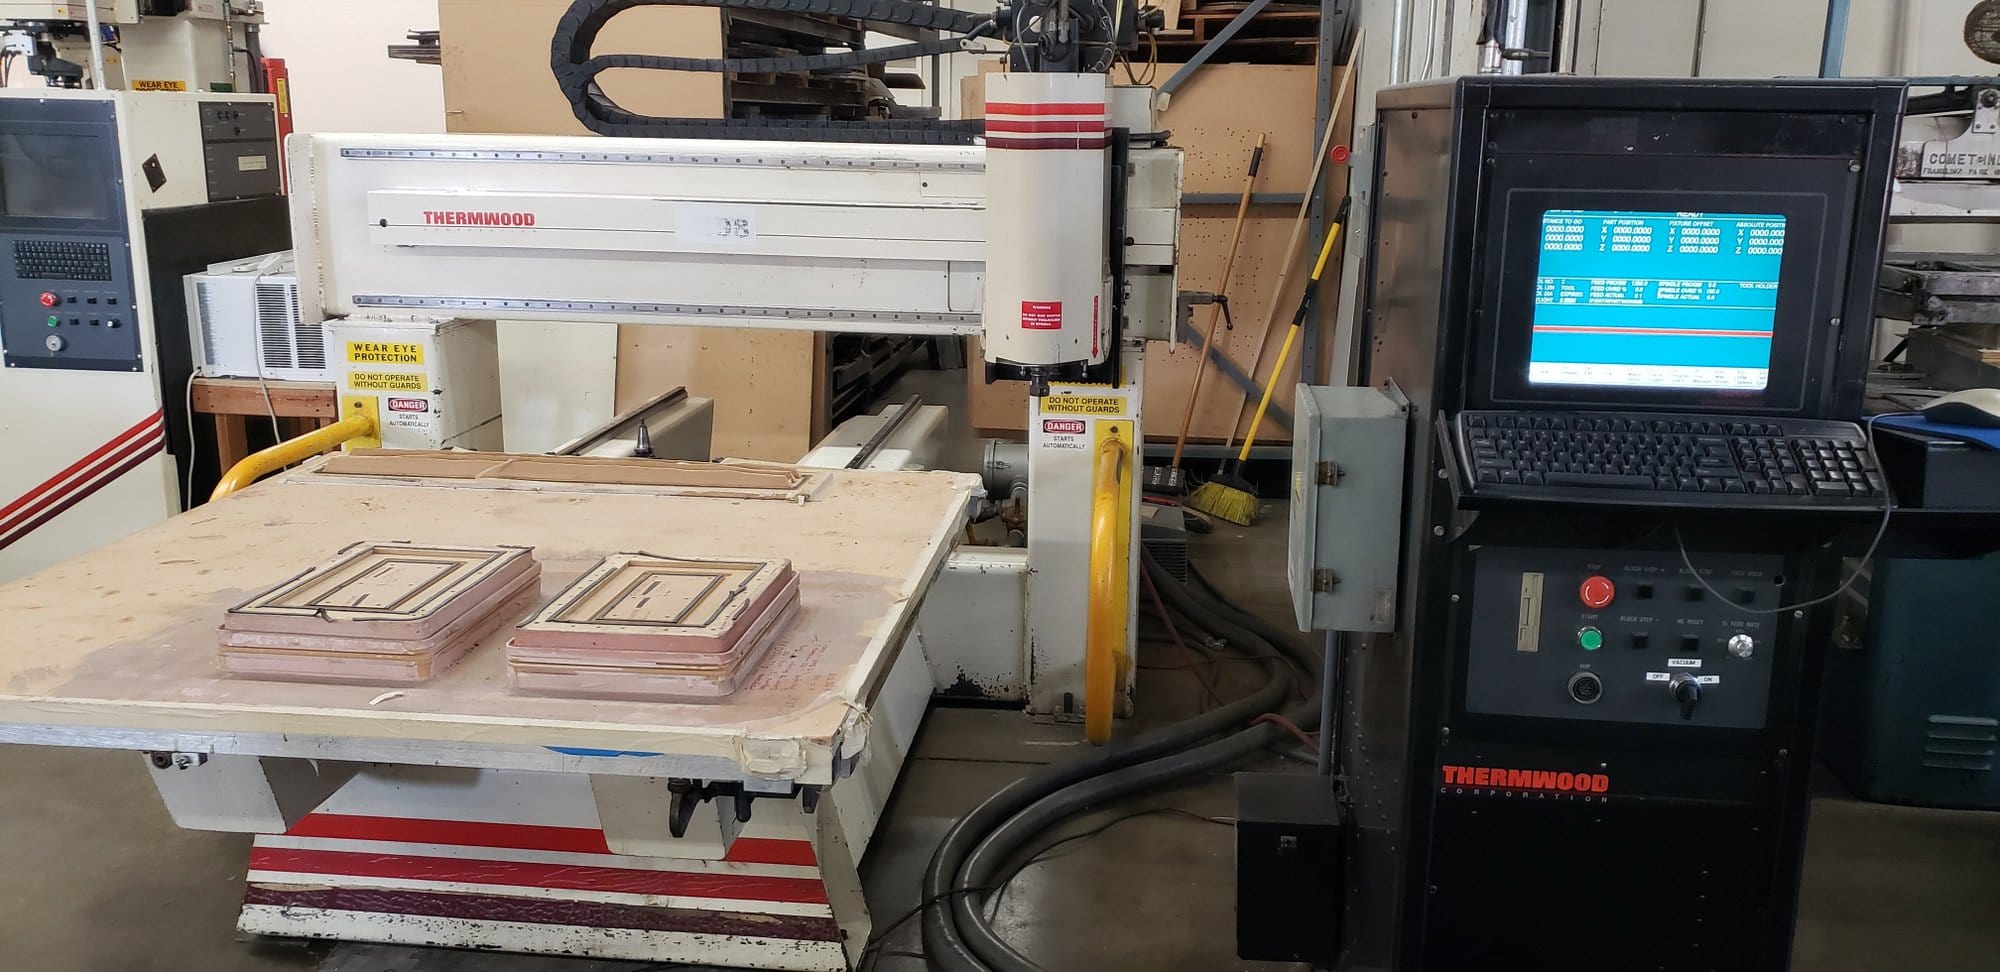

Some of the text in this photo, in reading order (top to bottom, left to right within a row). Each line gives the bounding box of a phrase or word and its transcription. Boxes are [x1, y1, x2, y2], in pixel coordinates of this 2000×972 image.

[1930, 153, 1977, 165] COMET
[423, 211, 535, 226] THERMWOOD
[1546, 225, 1584, 233] 0000.0000
[1601, 226, 1652, 235] X 0000.0000
[1681, 228, 1720, 236] 0000.0000
[1750, 229, 1785, 237] 0000.000
[1545, 234, 1583, 242] 0000.0000
[1612, 235, 1651, 243] 0000.0000
[1668, 236, 1720, 245] Y 0000.0000
[1749, 238, 1784, 246] 0000.000
[1599, 243, 1650, 252] Z 0000.0000
[1679, 245, 1718, 253] 0000.0000
[1747, 247, 1783, 255] 0000.000
[353, 343, 417, 353] WEAR EYE
[354, 353, 417, 362] PROTECTION
[389, 382, 421, 390] GUARDS
[392, 400, 425, 409] DANGER
[1081, 398, 1119, 406] OPERATE
[1085, 406, 1120, 414] GUARDS
[1047, 422, 1082, 431] DANGER
[1442, 765, 1609, 792] THERMWOOD
[1440, 787, 1608, 803] CORPORATION
